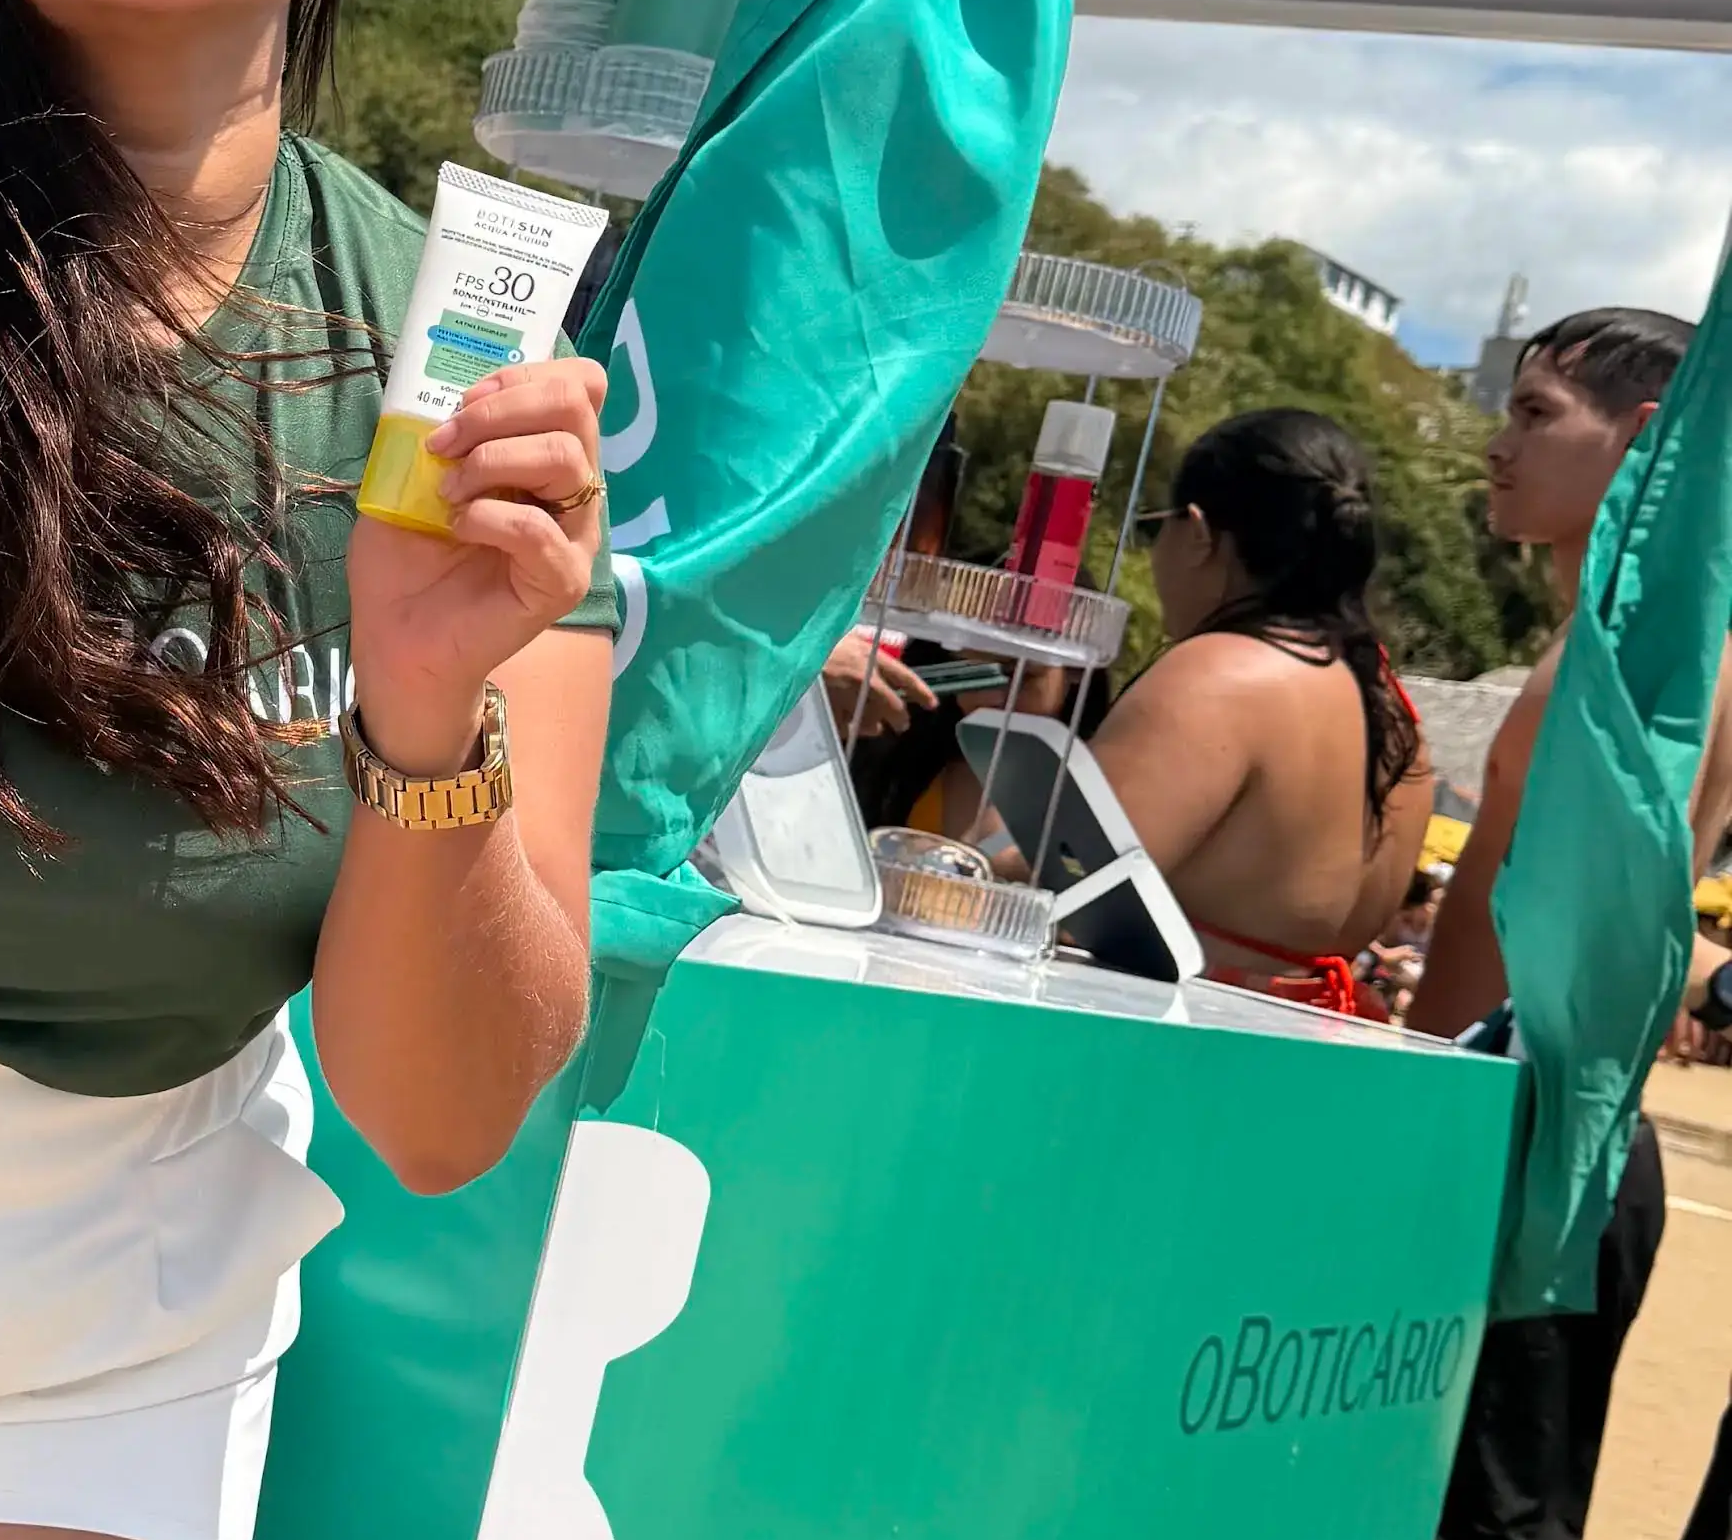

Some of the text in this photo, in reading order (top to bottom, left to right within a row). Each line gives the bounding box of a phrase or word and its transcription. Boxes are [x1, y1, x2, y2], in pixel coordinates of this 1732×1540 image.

[455, 266, 535, 302] FPS 30
[431, 395, 446, 407] ml
